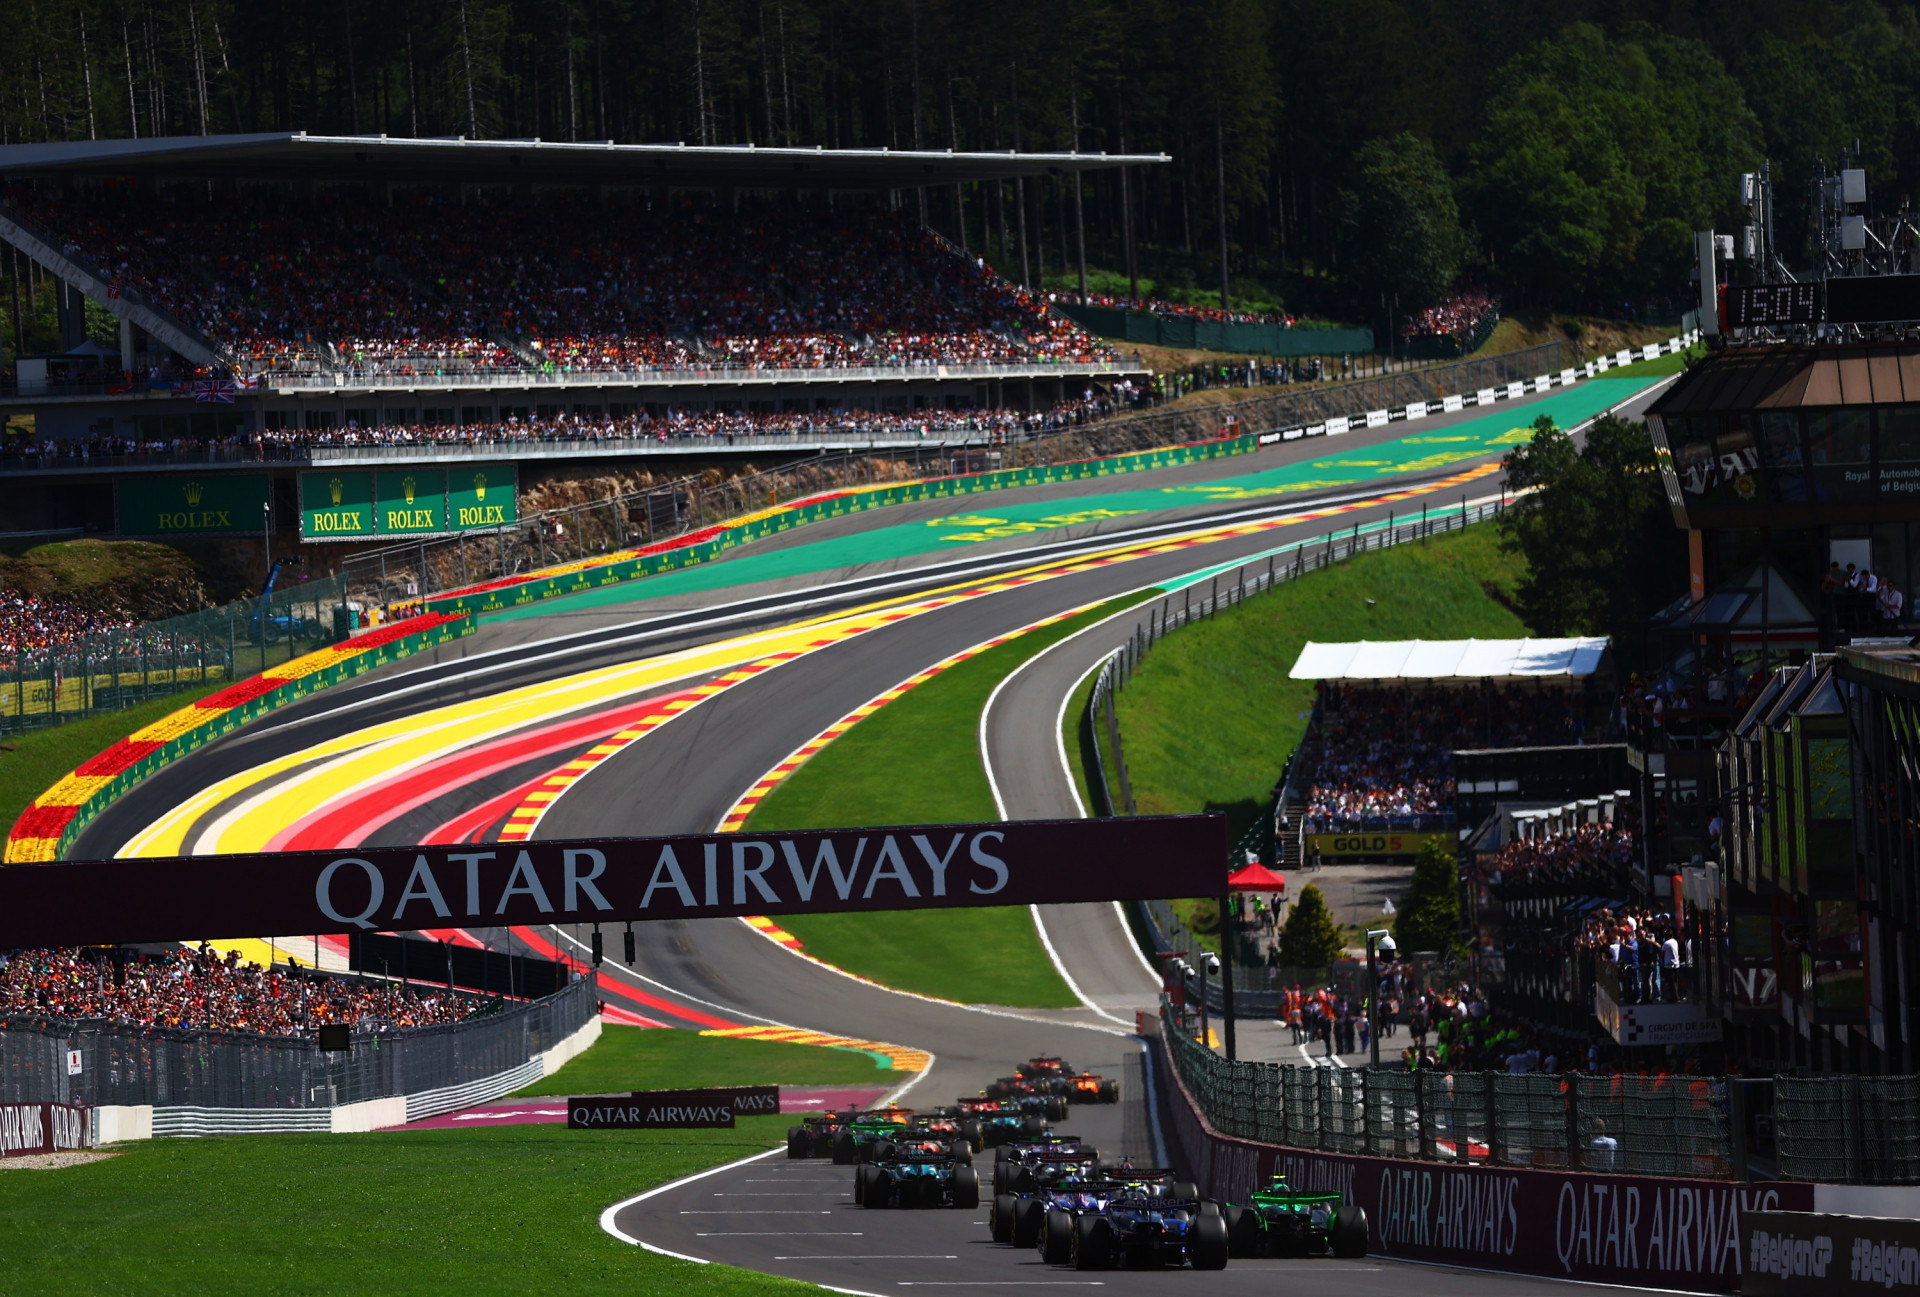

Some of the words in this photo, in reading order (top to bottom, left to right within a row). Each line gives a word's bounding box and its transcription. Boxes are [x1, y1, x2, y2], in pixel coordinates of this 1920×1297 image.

[1741, 286, 1814, 323] 15:04
[1845, 471, 1870, 482] Royal
[1881, 483, 1889, 491] of
[159, 511, 231, 529] ROLEX
[314, 512, 361, 531] ROLEX
[388, 510, 433, 529] ROLEX
[459, 506, 503, 525] ROLEX
[1334, 837, 1386, 851] GOLD
[1390, 836, 1402, 851] 5
[314, 848, 614, 929] QATAR
[639, 830, 1010, 909] AIRWAYS
[1648, 1023, 1682, 1032] CIRCUIT
[1686, 1022, 1697, 1031] DE
[1701, 1021, 1717, 1029] SPA
[573, 1107, 640, 1126] QATAR
[646, 1106, 731, 1122] AIRWAYS
[1136, 1198, 1187, 1208] kraken
[1379, 1167, 1432, 1249] QATAR
[1434, 1171, 1519, 1255] AIRWAYS
[1556, 1181, 1640, 1273] QATAR
[1647, 1186, 1779, 1275] AIRWA
[1751, 1230, 1833, 1280] #BelgianGP
[1850, 1237, 1920, 1289] #Belgian
